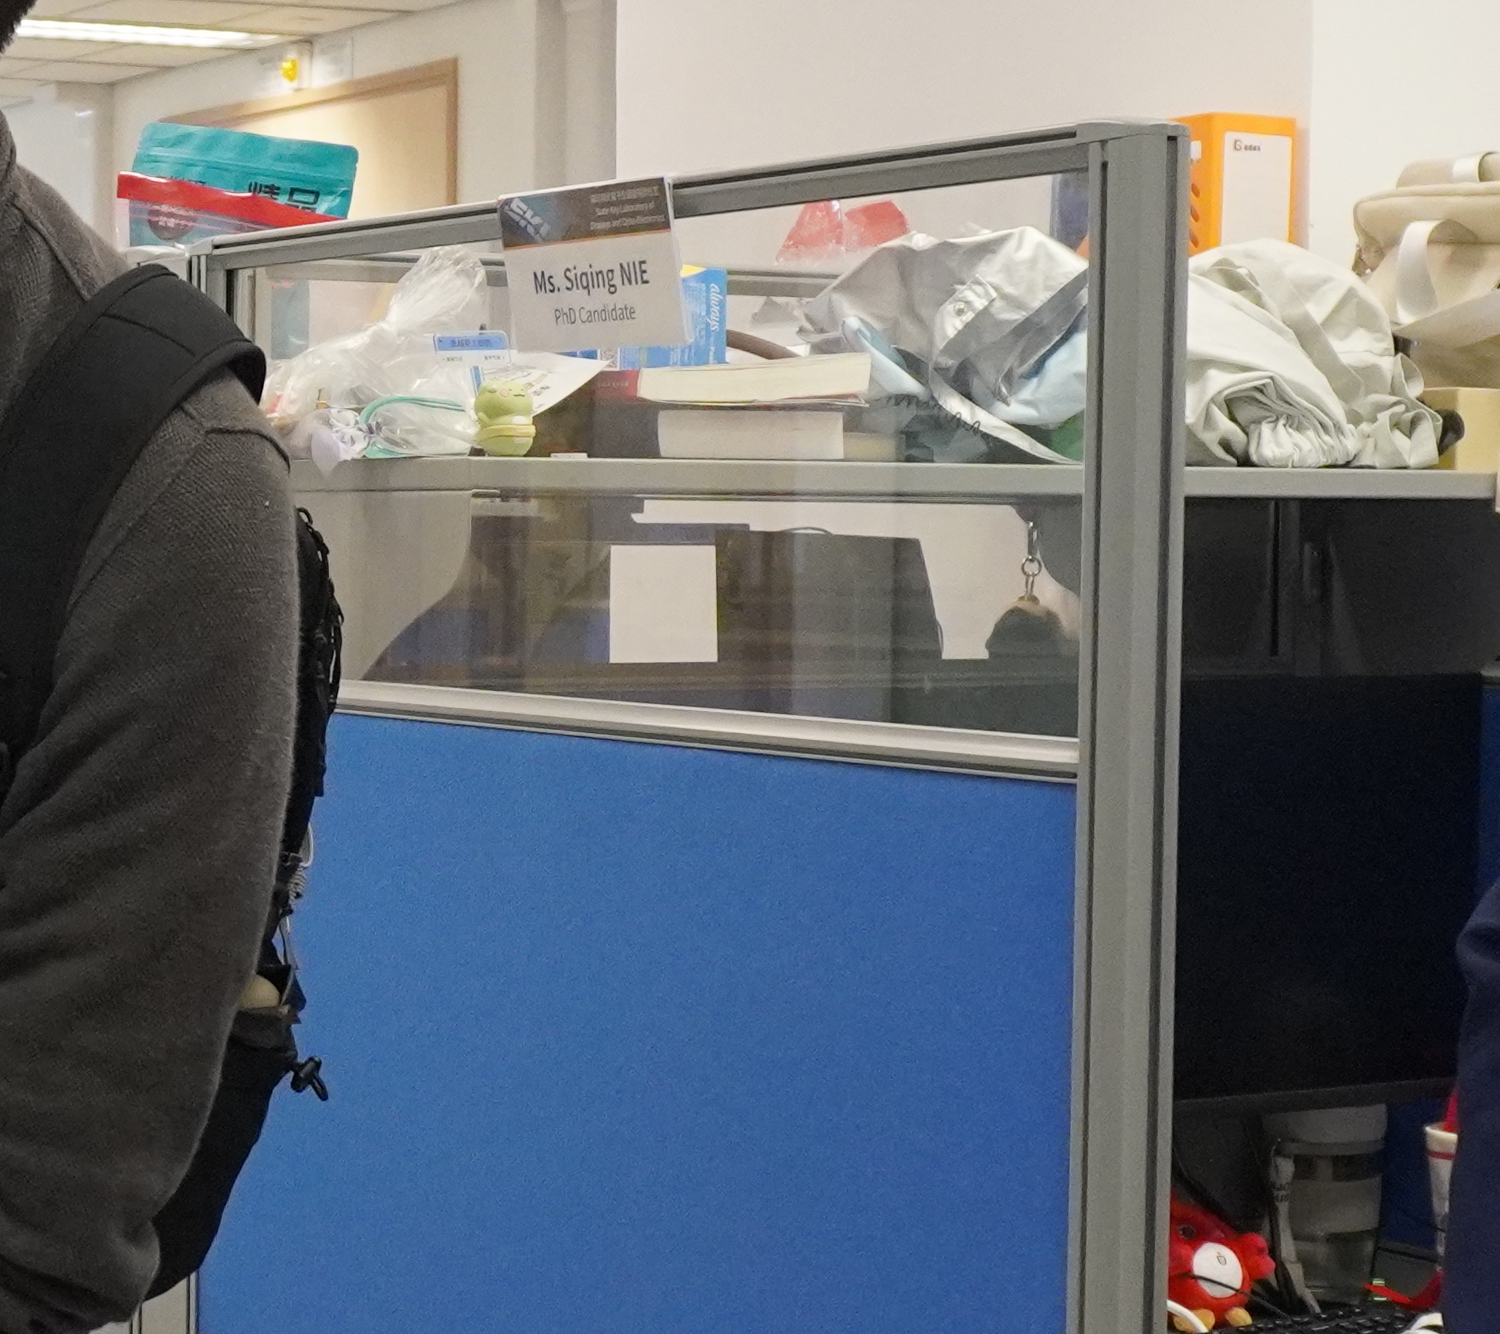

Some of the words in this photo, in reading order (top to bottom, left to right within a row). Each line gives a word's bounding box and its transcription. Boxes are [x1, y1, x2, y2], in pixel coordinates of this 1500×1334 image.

[533, 270, 560, 295] Ms.
[564, 263, 617, 297] Siqing
[619, 260, 650, 287] NIE
[554, 307, 577, 326] PhD
[578, 303, 637, 324] Candidate
[707, 282, 722, 332] always
